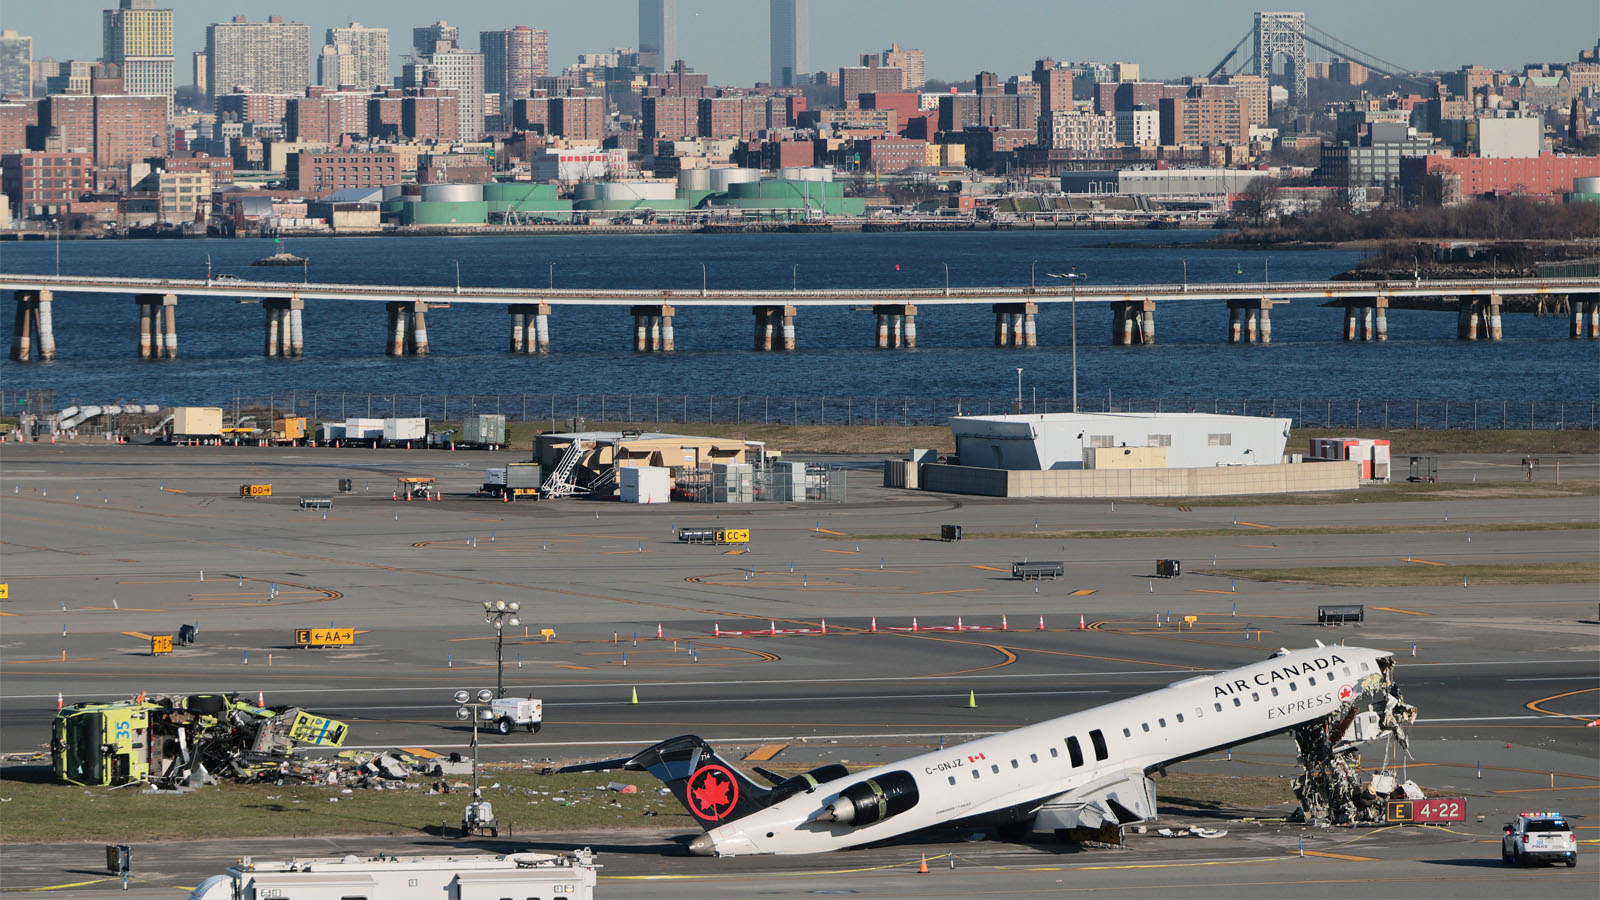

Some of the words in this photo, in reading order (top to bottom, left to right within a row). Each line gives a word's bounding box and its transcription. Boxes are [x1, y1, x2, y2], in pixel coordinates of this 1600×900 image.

[243, 486, 249, 494] E
[716, 531, 722, 540] E
[728, 532, 739, 540] CC
[300, 631, 307, 642] E
[325, 631, 341, 641] AA
[1214, 679, 1250, 698] AIR
[1254, 655, 1345, 686] CANADA
[1268, 692, 1332, 720] EXPRESS
[116, 721, 130, 740] 35
[925, 758, 964, 774] C-GNJZ
[1396, 804, 1404, 818] E
[1420, 803, 1458, 818] 4-22
